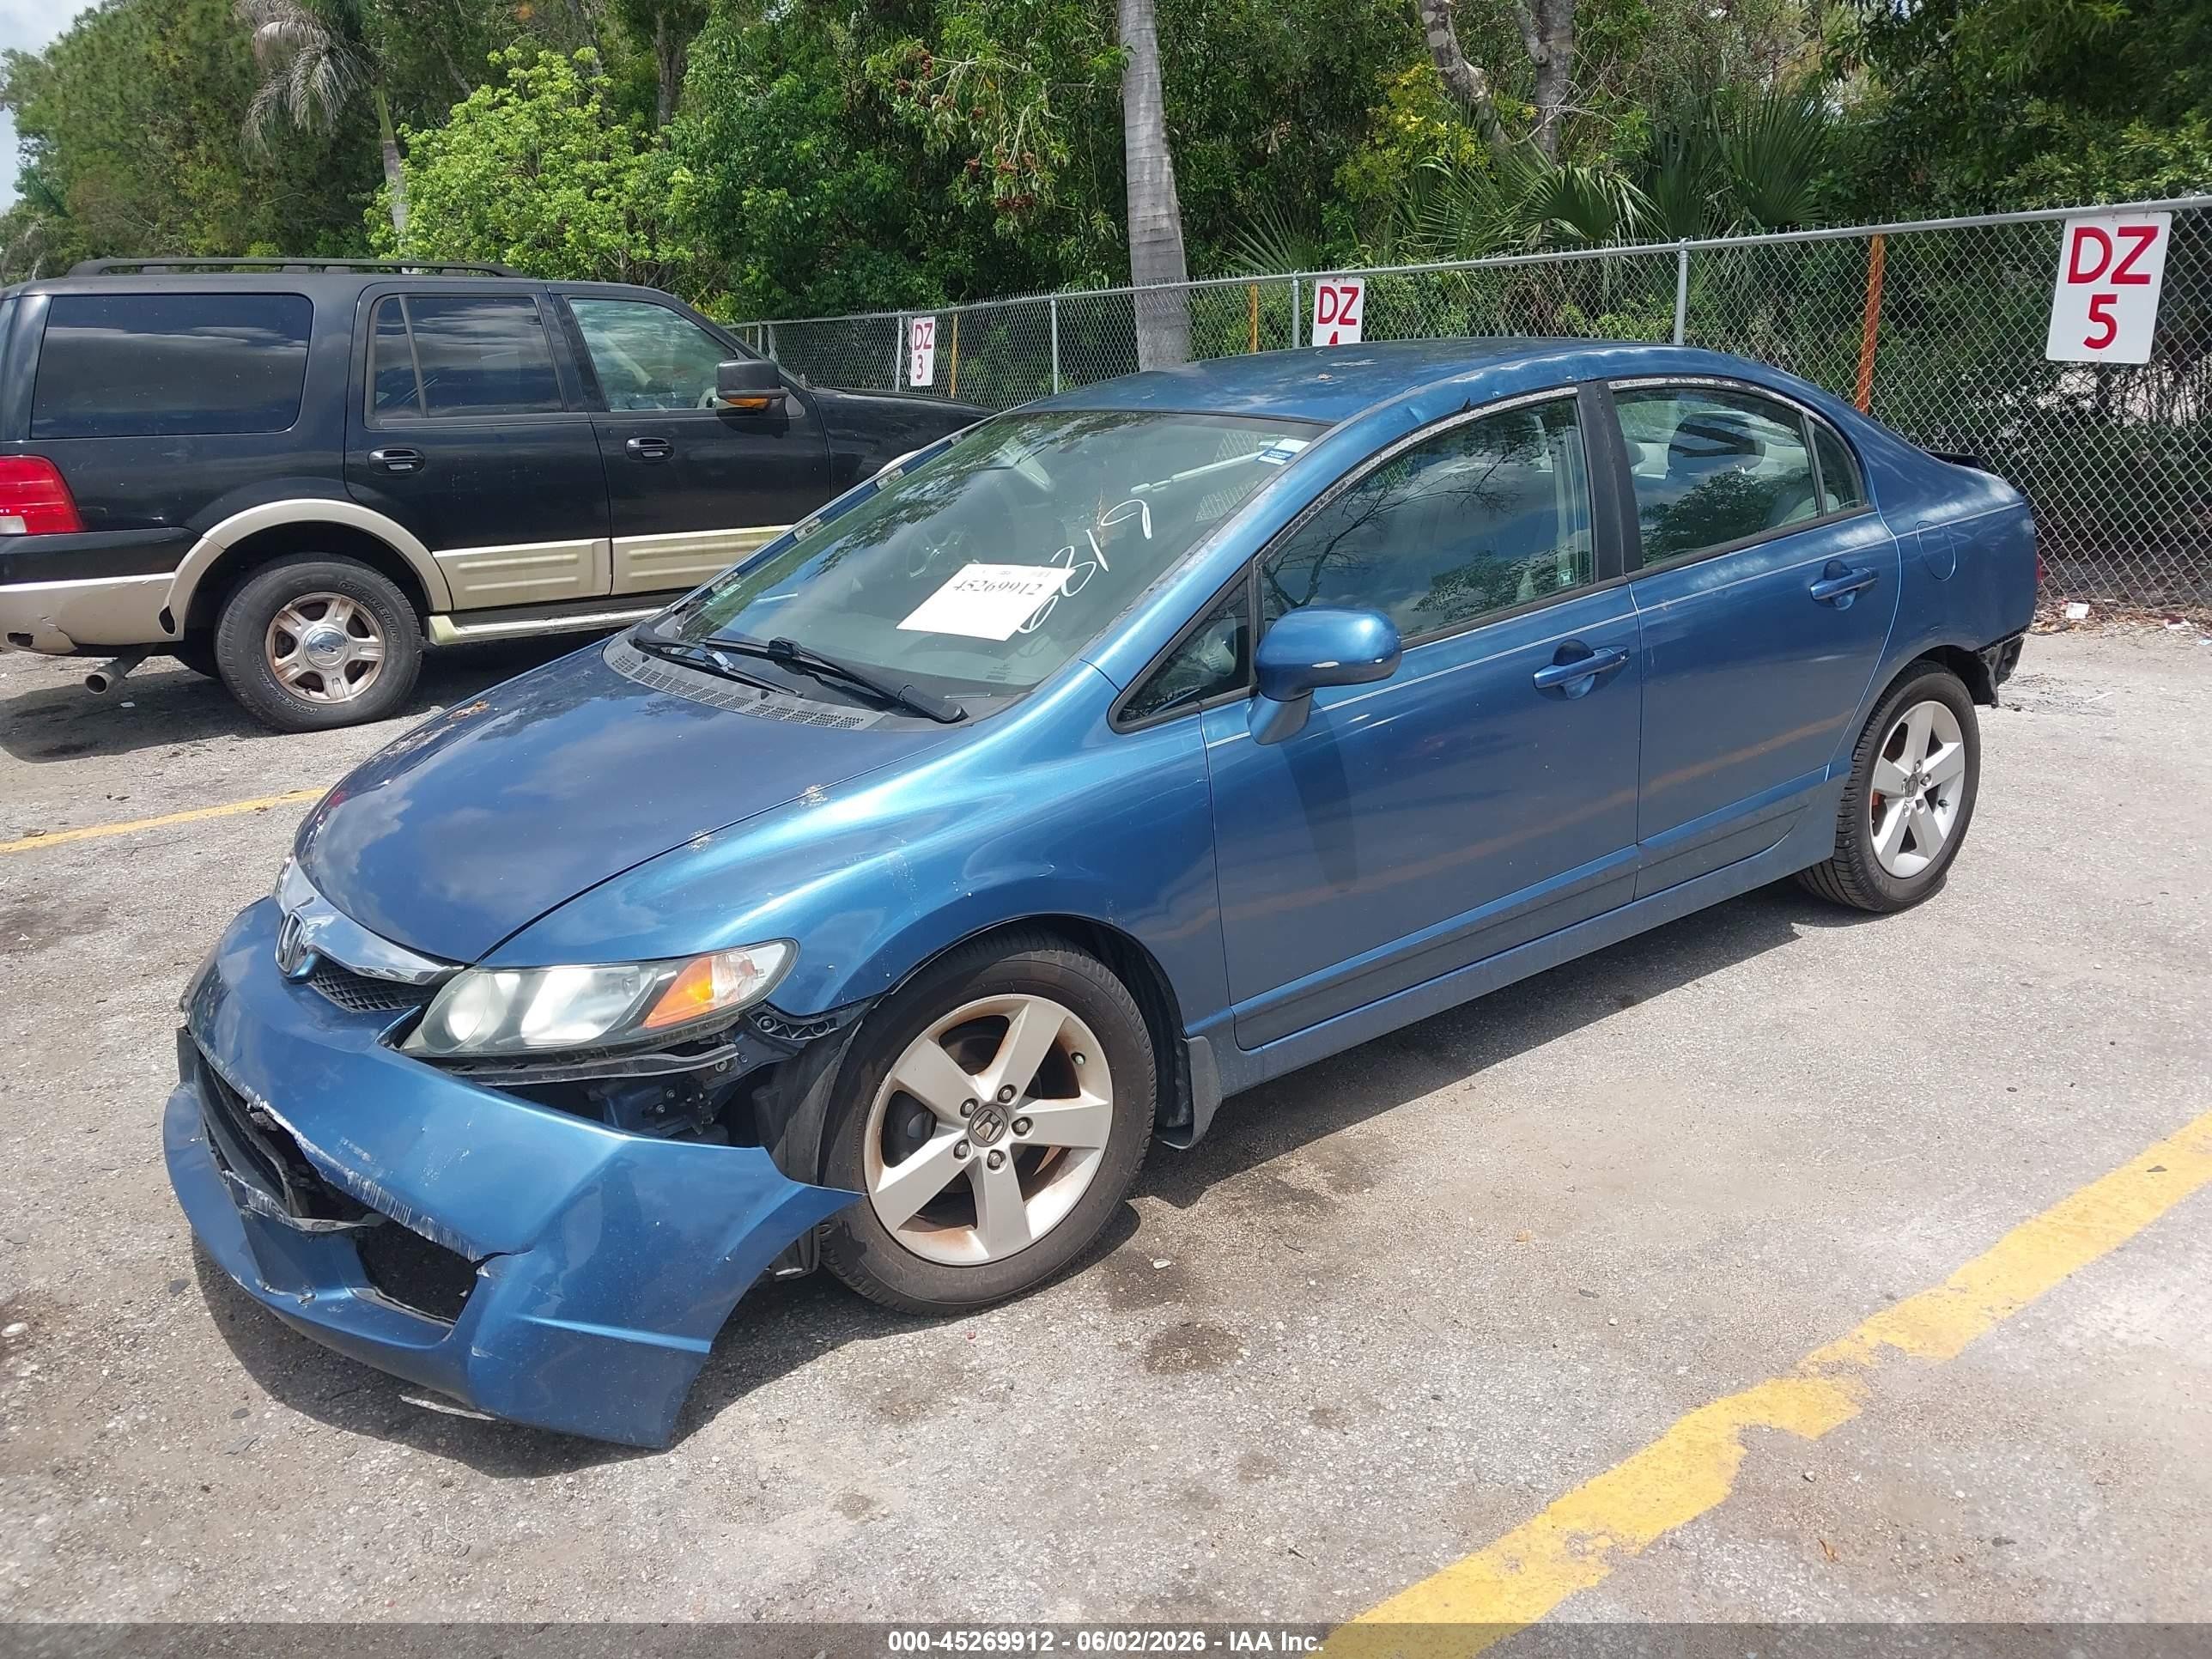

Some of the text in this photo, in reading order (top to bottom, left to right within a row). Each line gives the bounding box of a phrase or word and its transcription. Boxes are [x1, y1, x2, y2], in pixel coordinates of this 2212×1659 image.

[2067, 225, 2160, 285] DZ
[1317, 286, 1359, 325] DZ
[2082, 294, 2118, 349] 5
[914, 322, 933, 351] DZ
[915, 354, 924, 380] 3
